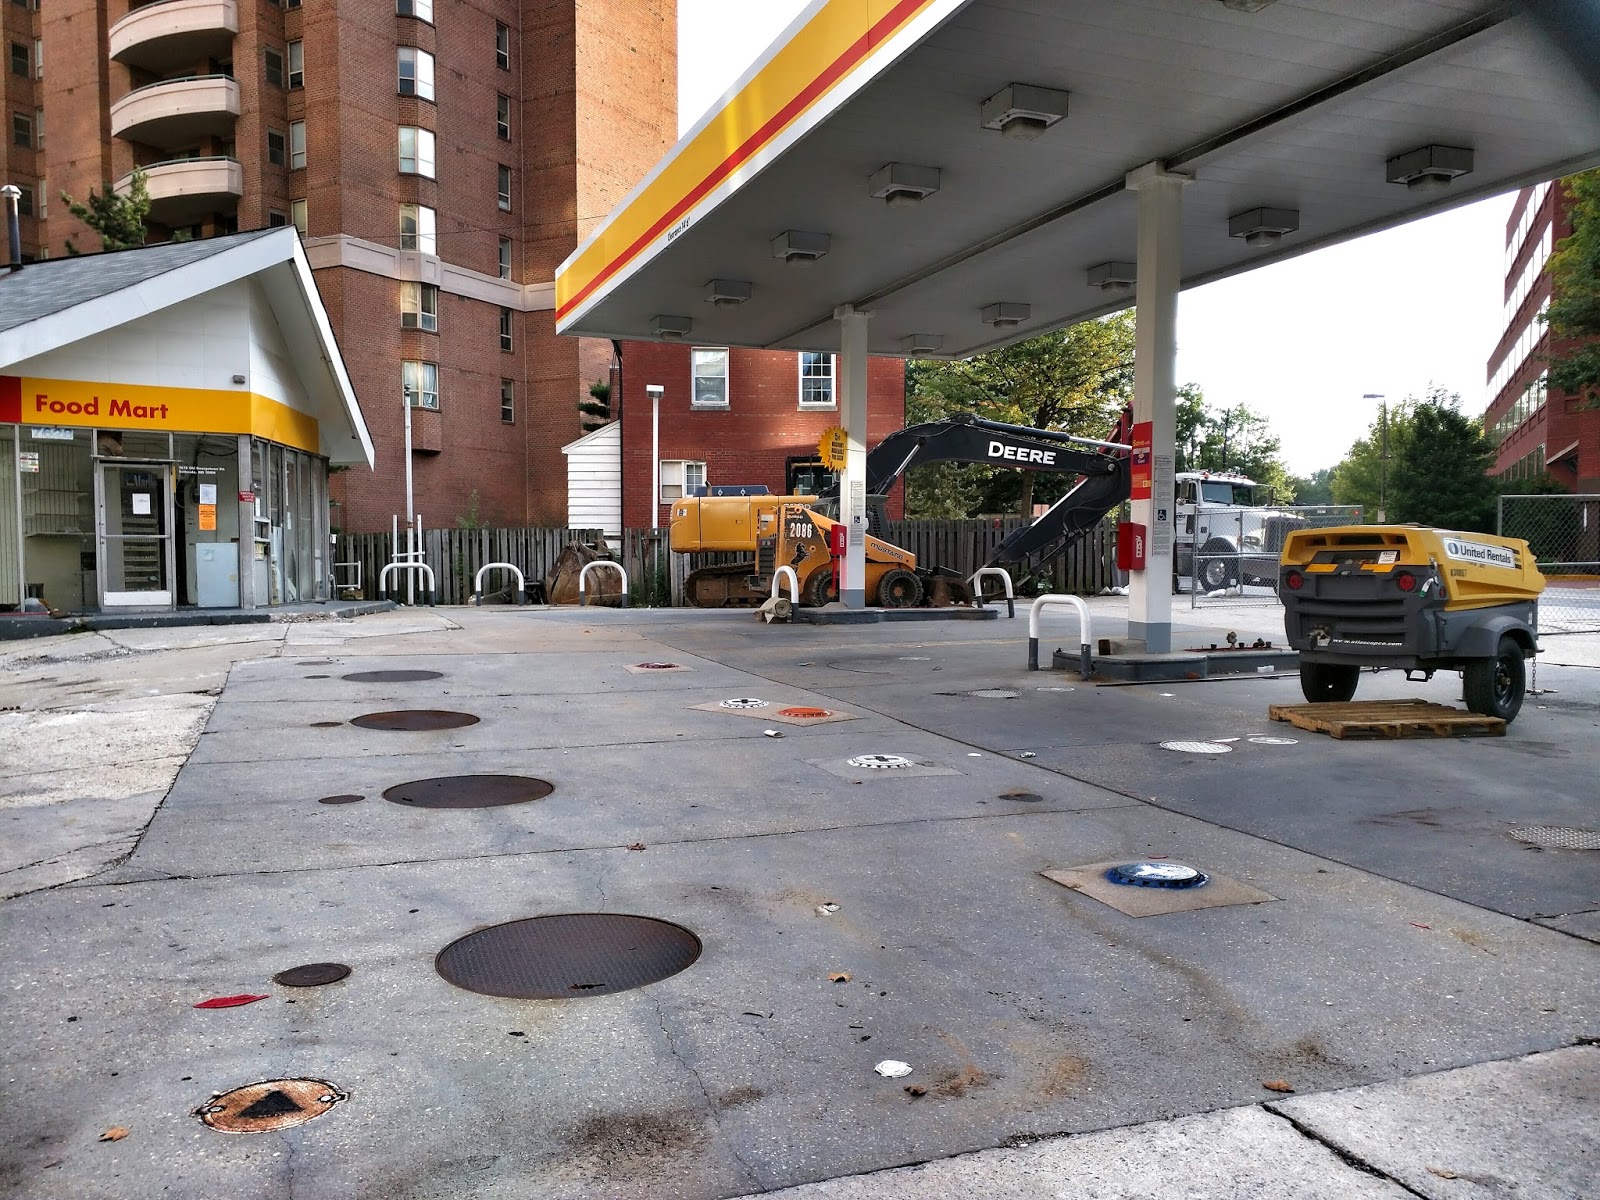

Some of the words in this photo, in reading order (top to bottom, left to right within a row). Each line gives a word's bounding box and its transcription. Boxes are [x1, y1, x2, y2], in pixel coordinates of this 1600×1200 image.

[35, 394, 99, 415] Food
[108, 399, 169, 419] Mart
[988, 440, 1057, 465] DEERE
[790, 522, 813, 538] 2086
[1460, 544, 1486, 559] United
[1487, 549, 1512, 564] Rentals
